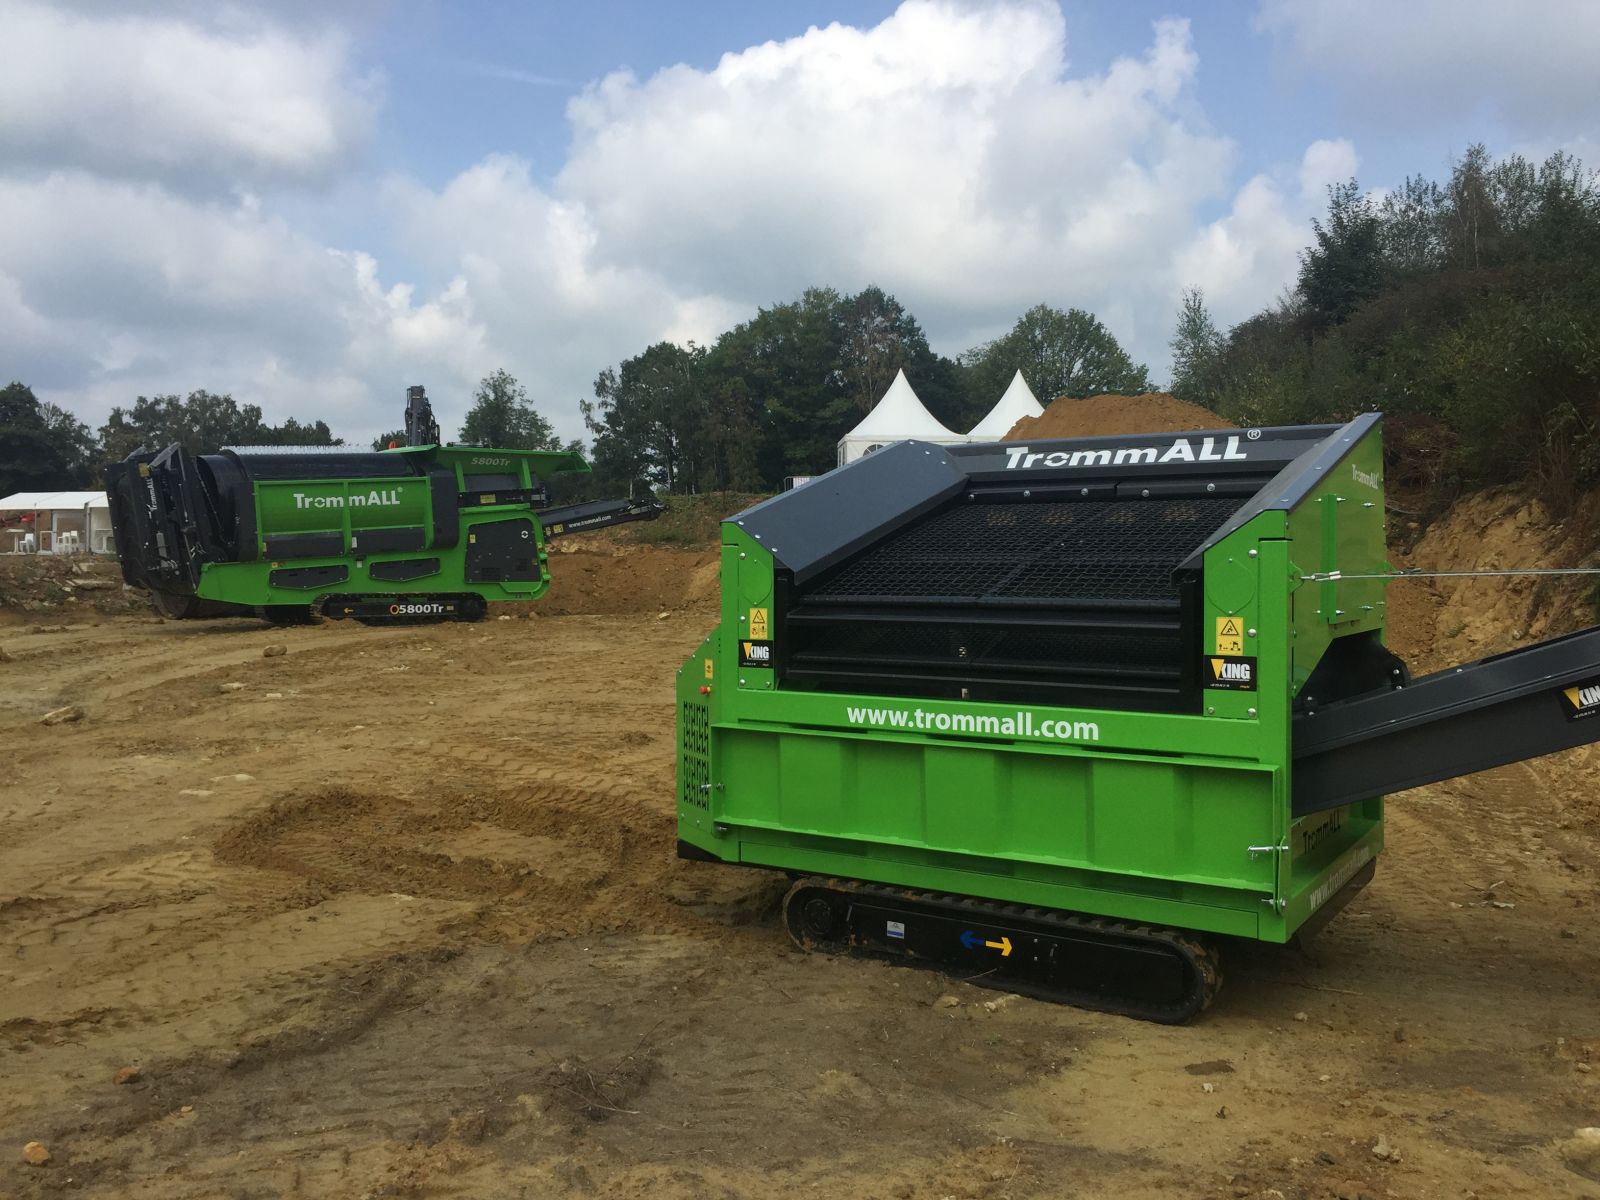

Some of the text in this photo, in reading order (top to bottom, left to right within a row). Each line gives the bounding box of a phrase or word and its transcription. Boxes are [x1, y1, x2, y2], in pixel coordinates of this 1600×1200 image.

[470, 457, 511, 467] 5800Tr
[293, 489, 401, 509] TrommALL
[568, 514, 612, 529] www.trommall.com
[847, 706, 1100, 741] www.trommall.com
